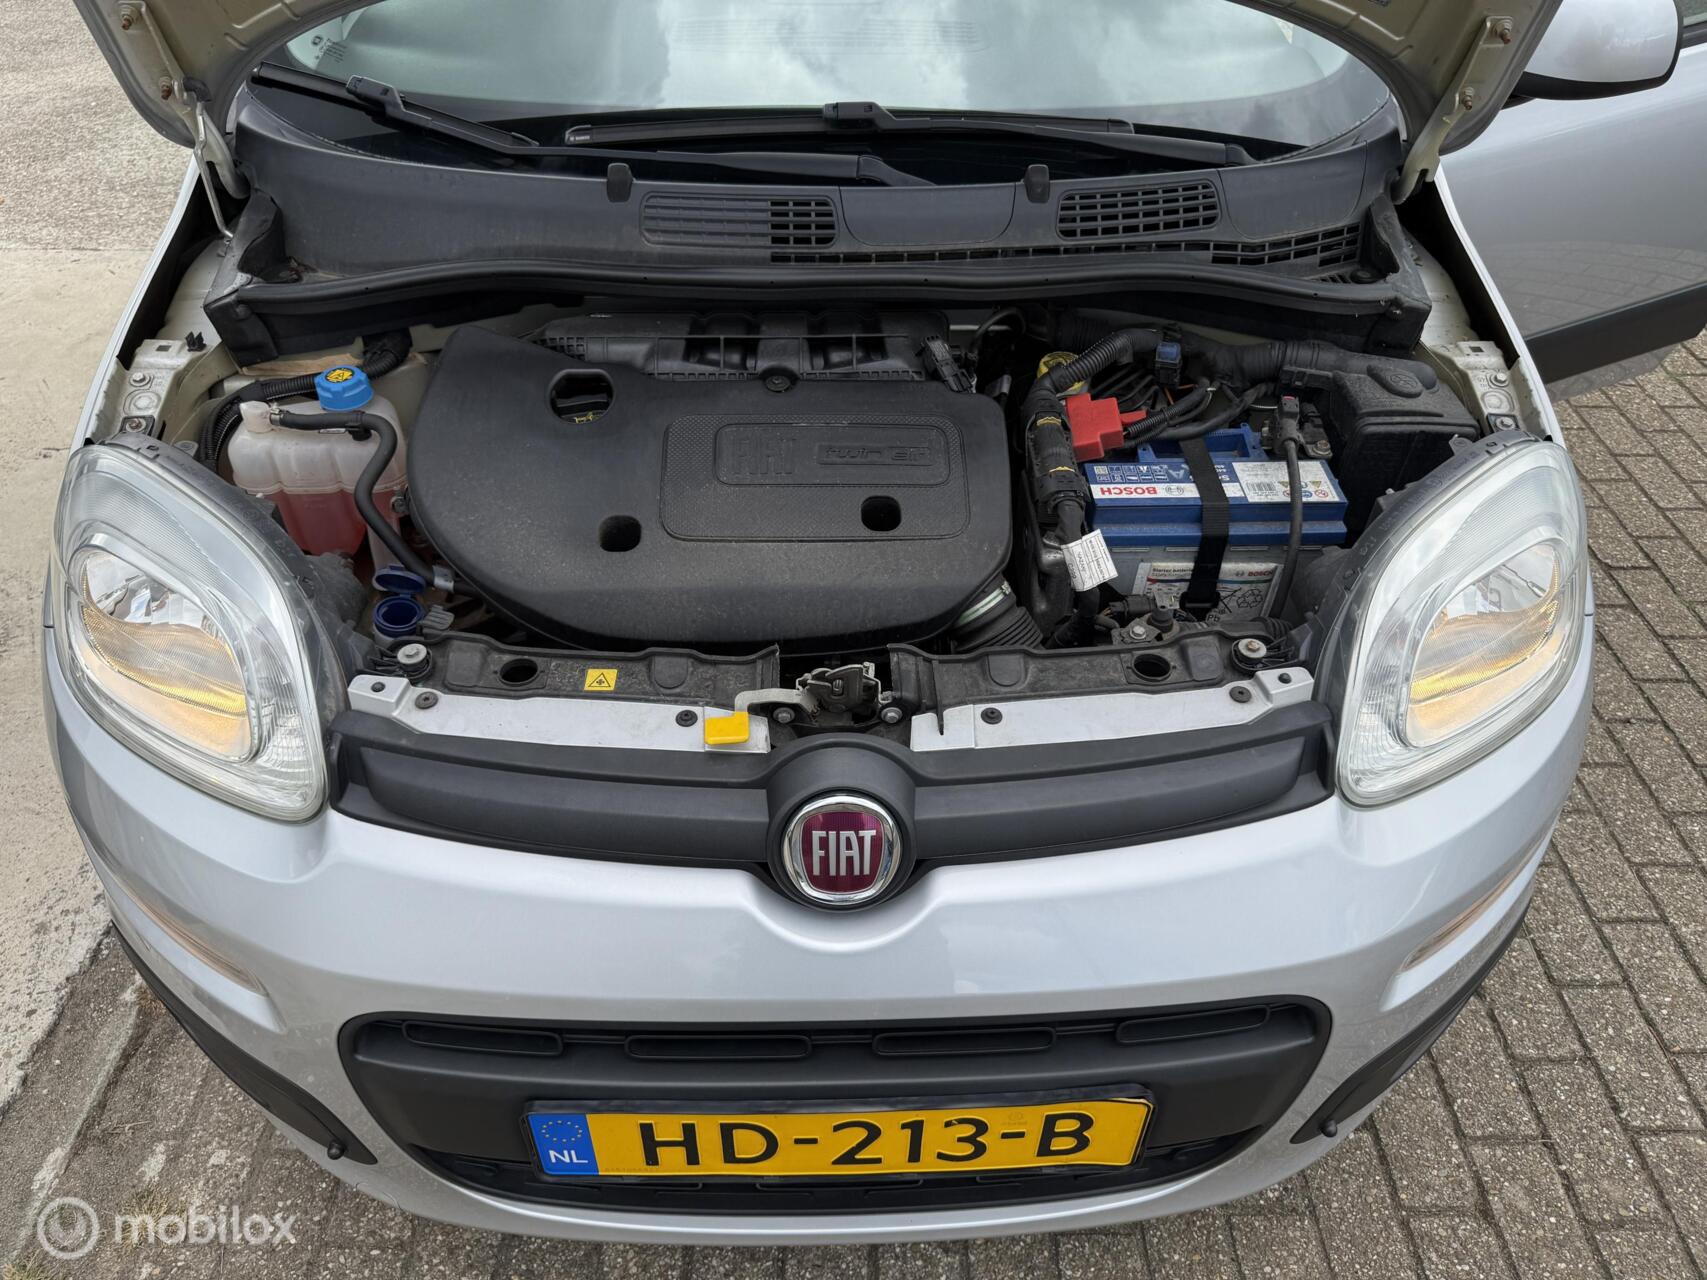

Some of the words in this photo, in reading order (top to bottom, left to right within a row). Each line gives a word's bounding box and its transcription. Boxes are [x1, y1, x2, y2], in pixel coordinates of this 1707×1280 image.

[1100, 486, 1158, 496] BOSCH
[811, 829, 877, 876] FIAT
[638, 1110, 1095, 1167] HD-213-B
[548, 1149, 589, 1164] NL
